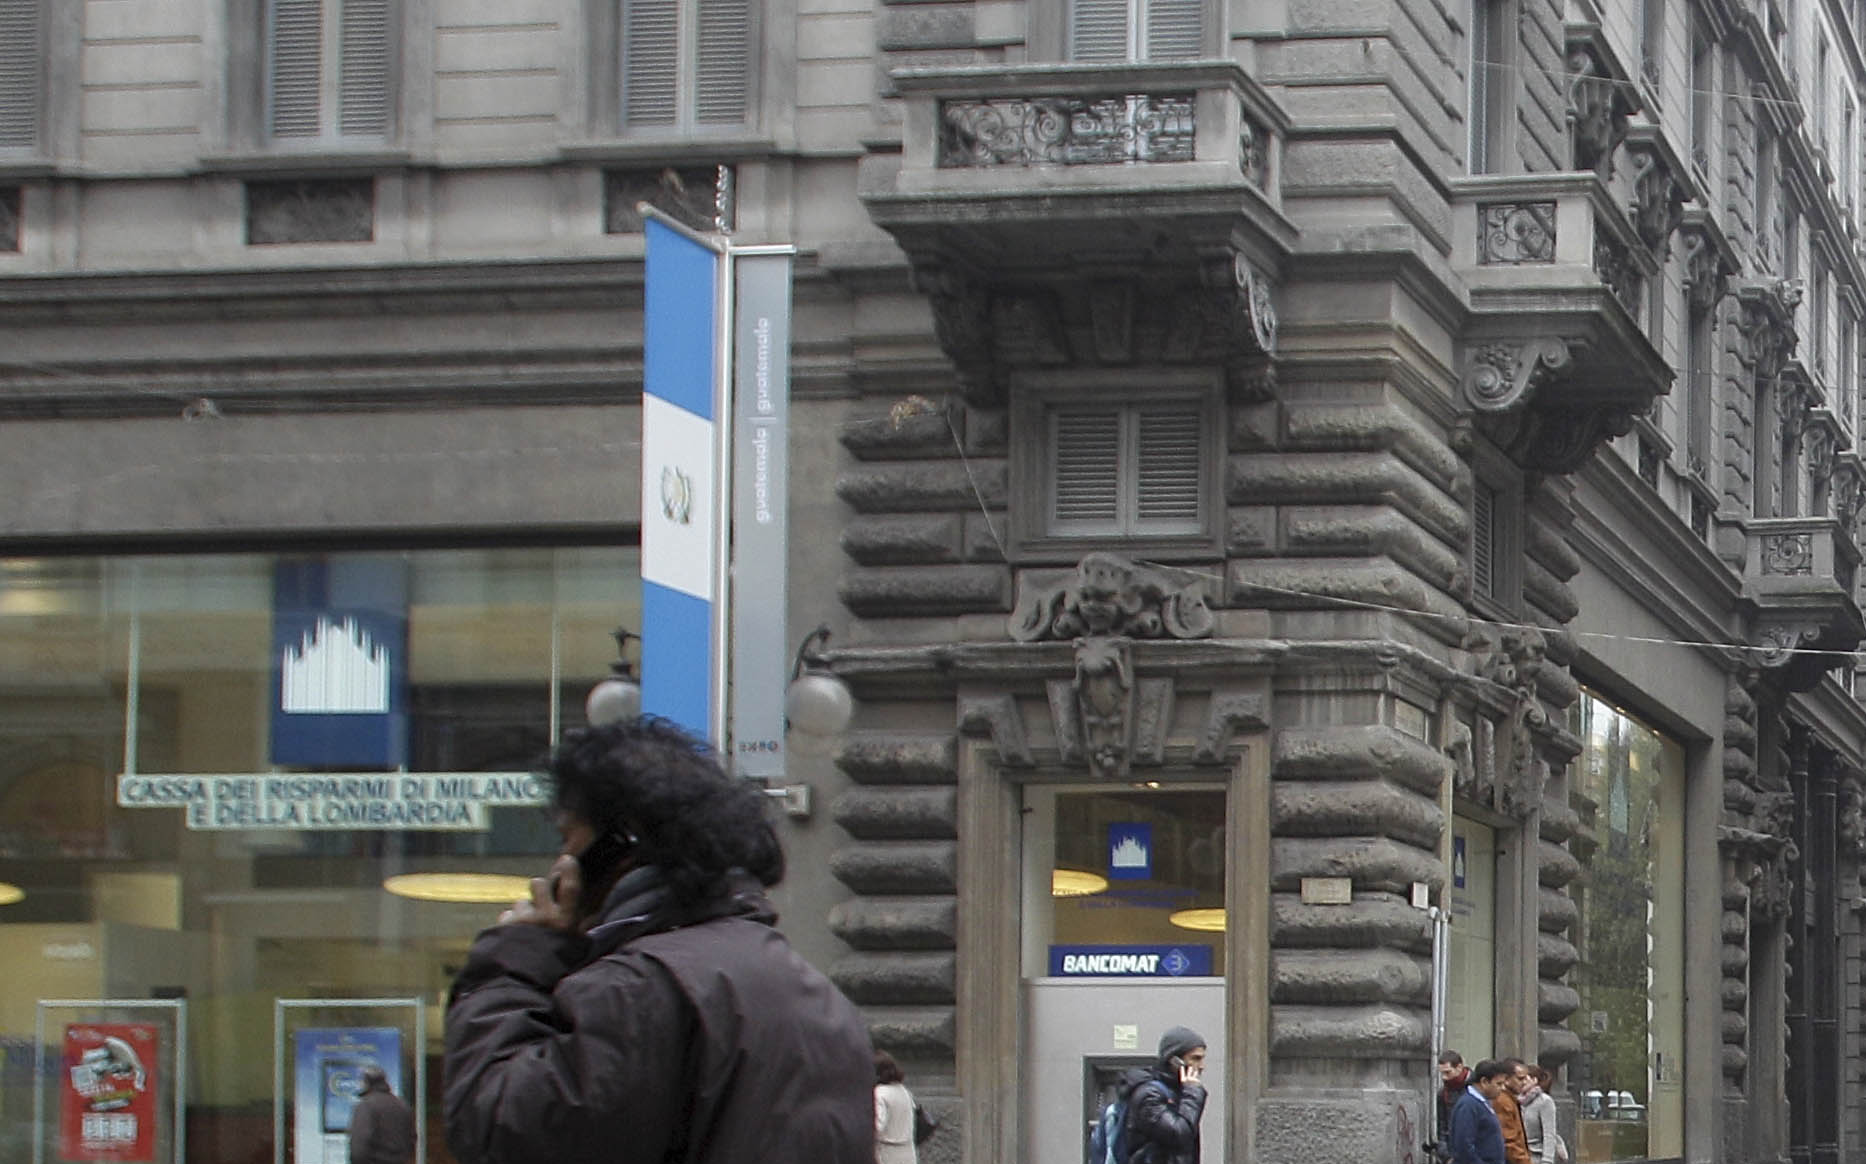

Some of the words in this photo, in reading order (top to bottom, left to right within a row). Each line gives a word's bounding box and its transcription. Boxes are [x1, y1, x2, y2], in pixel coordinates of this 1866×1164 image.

[126, 780, 206, 801] CASSA
[216, 779, 256, 800] DEI
[267, 778, 388, 800] RISPARMI
[401, 778, 424, 799] DI
[437, 777, 544, 799] MILANO
[192, 802, 206, 824] E
[216, 802, 299, 824] DELLA
[310, 801, 471, 824] LOMBARDIA
[1063, 955, 1160, 973] BANCOMAT
